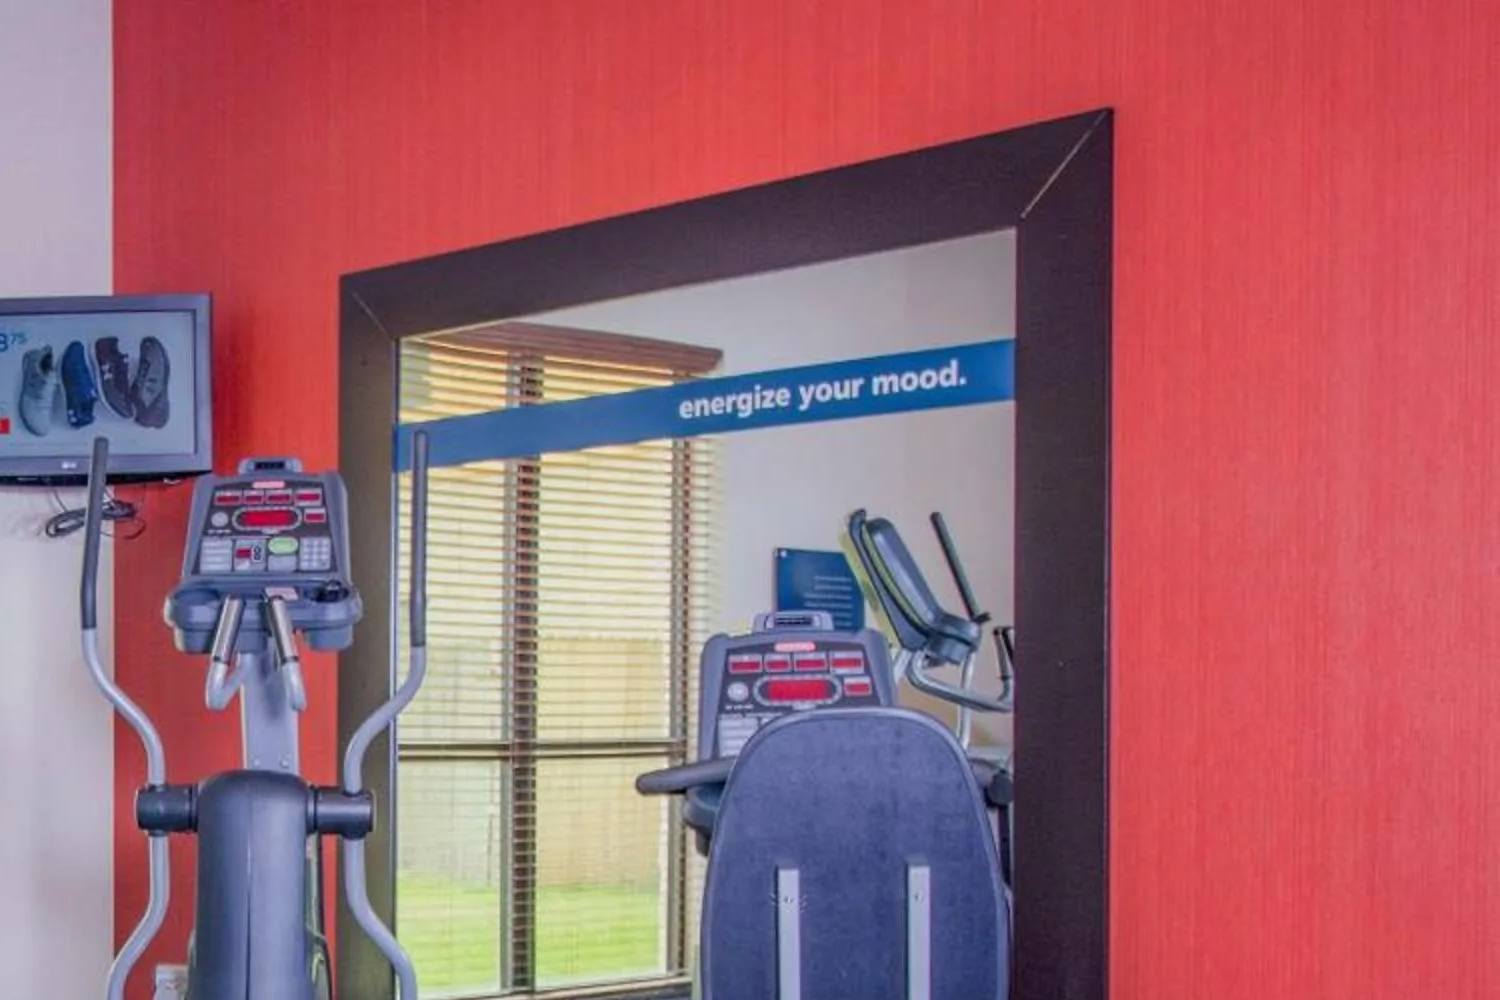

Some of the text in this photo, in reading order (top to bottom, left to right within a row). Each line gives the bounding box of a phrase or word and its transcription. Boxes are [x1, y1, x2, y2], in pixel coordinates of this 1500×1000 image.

[678, 359, 967, 419] energize your mood.
